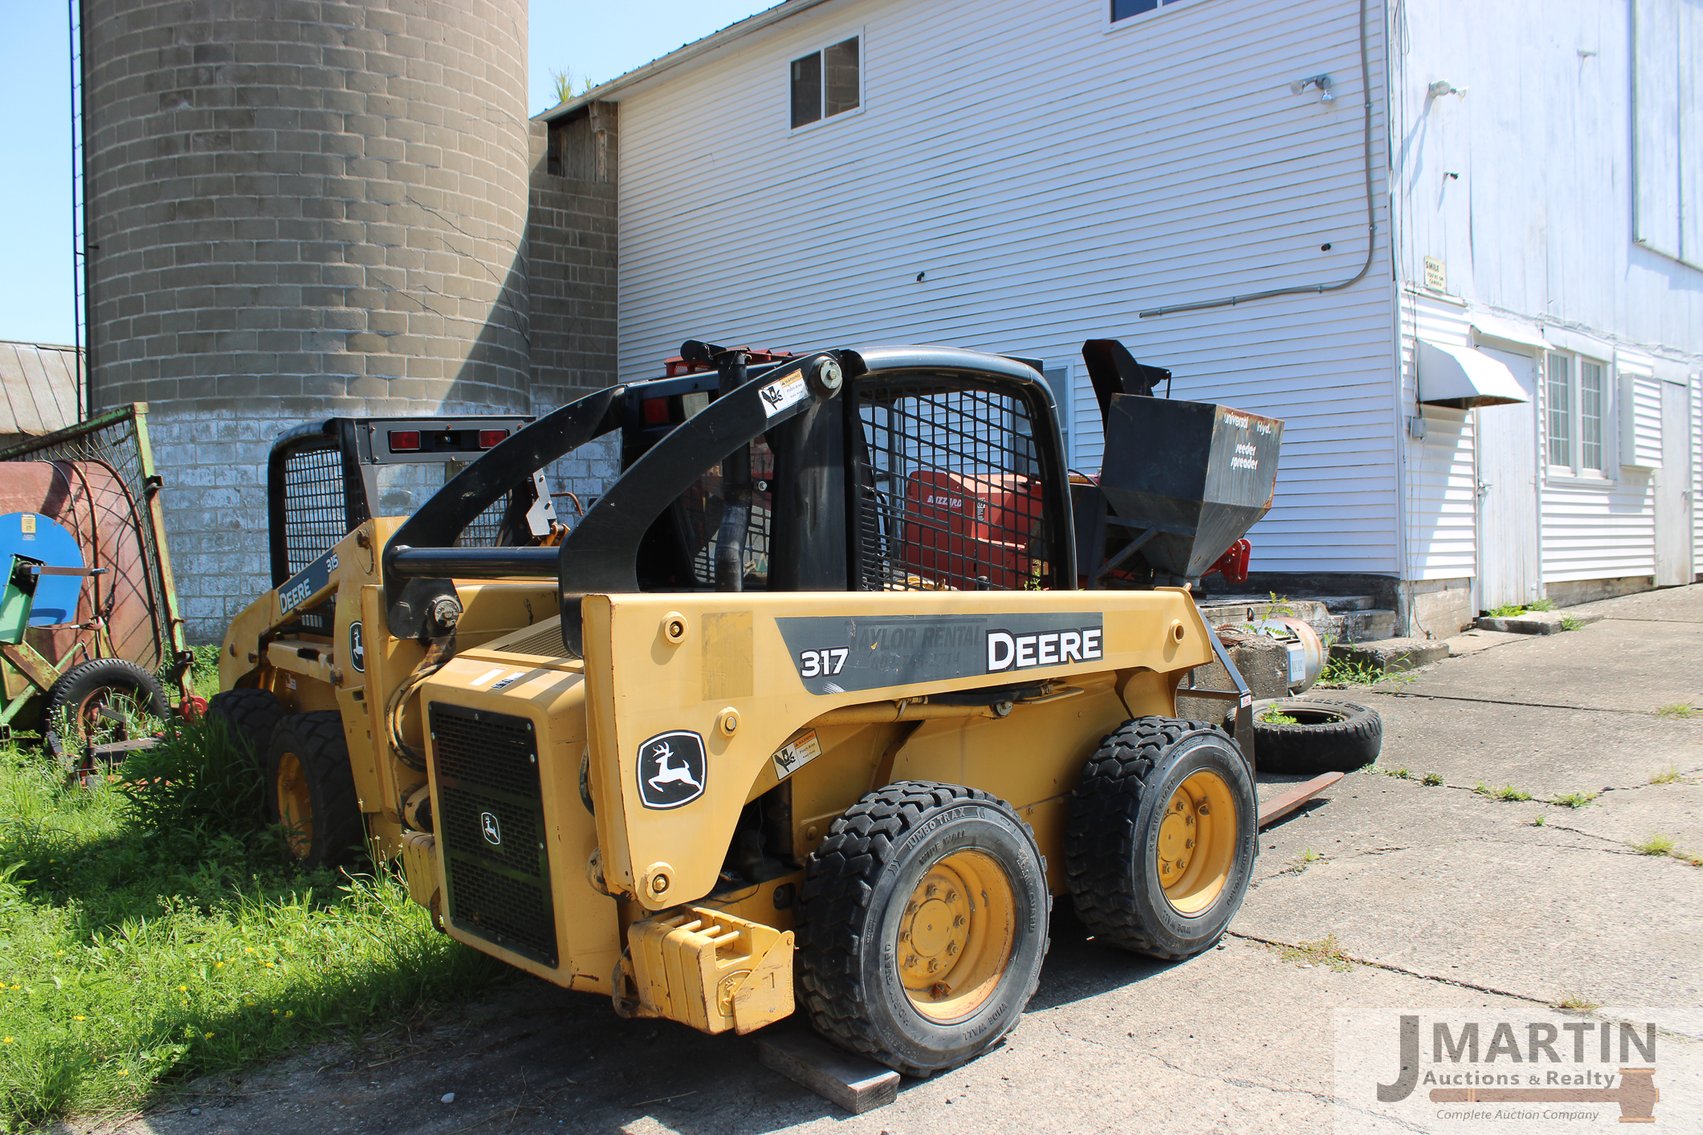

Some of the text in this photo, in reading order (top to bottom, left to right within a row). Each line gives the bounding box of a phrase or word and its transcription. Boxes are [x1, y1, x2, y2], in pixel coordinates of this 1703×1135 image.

[325, 553, 339, 573] 315
[279, 577, 312, 614] DEERE
[801, 647, 849, 677] 317
[987, 628, 1102, 672] DEERE
[906, 807, 966, 850] JUMBO TRAX
